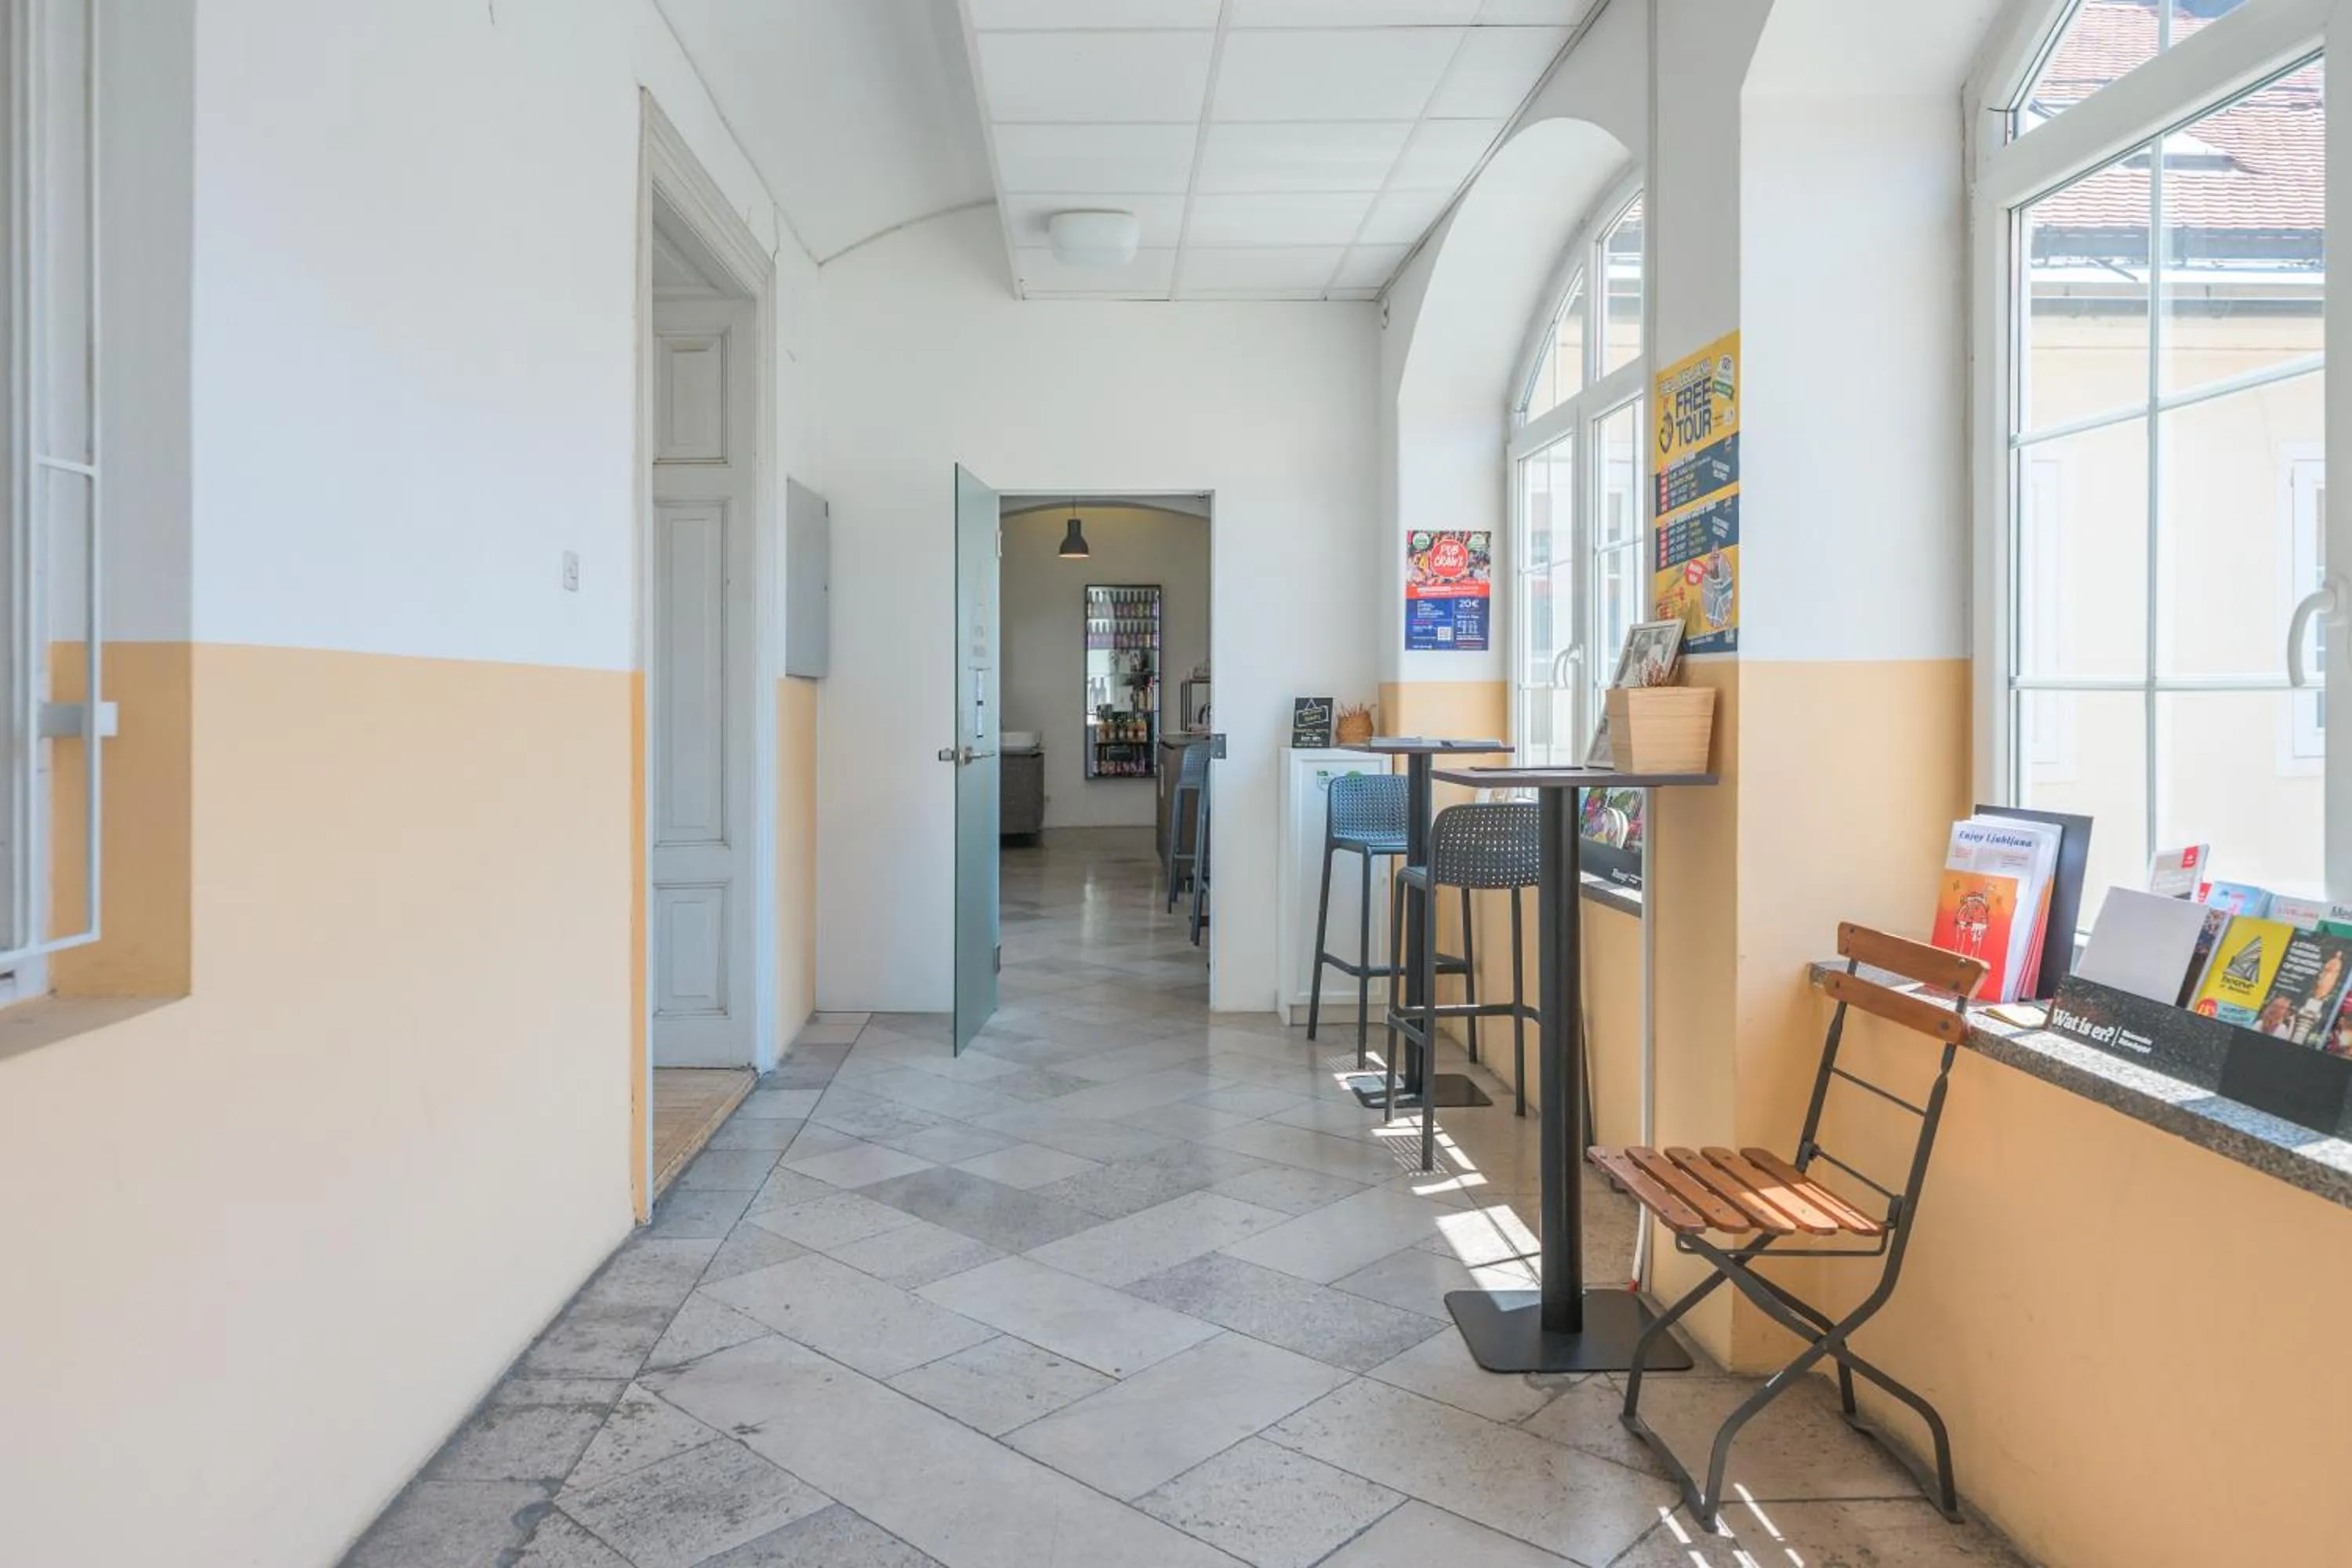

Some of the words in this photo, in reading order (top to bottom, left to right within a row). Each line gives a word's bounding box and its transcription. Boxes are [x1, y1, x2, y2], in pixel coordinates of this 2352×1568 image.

[1675, 376, 1711, 418] FREE
[1676, 407, 1711, 447] TOUR
[1959, 830, 1984, 843] Enjoy
[1986, 832, 2032, 848] Ljubljana
[2053, 1007, 2080, 1031] Wat
[2078, 1016, 2092, 1036] is
[2091, 1025, 2116, 1042] er?
